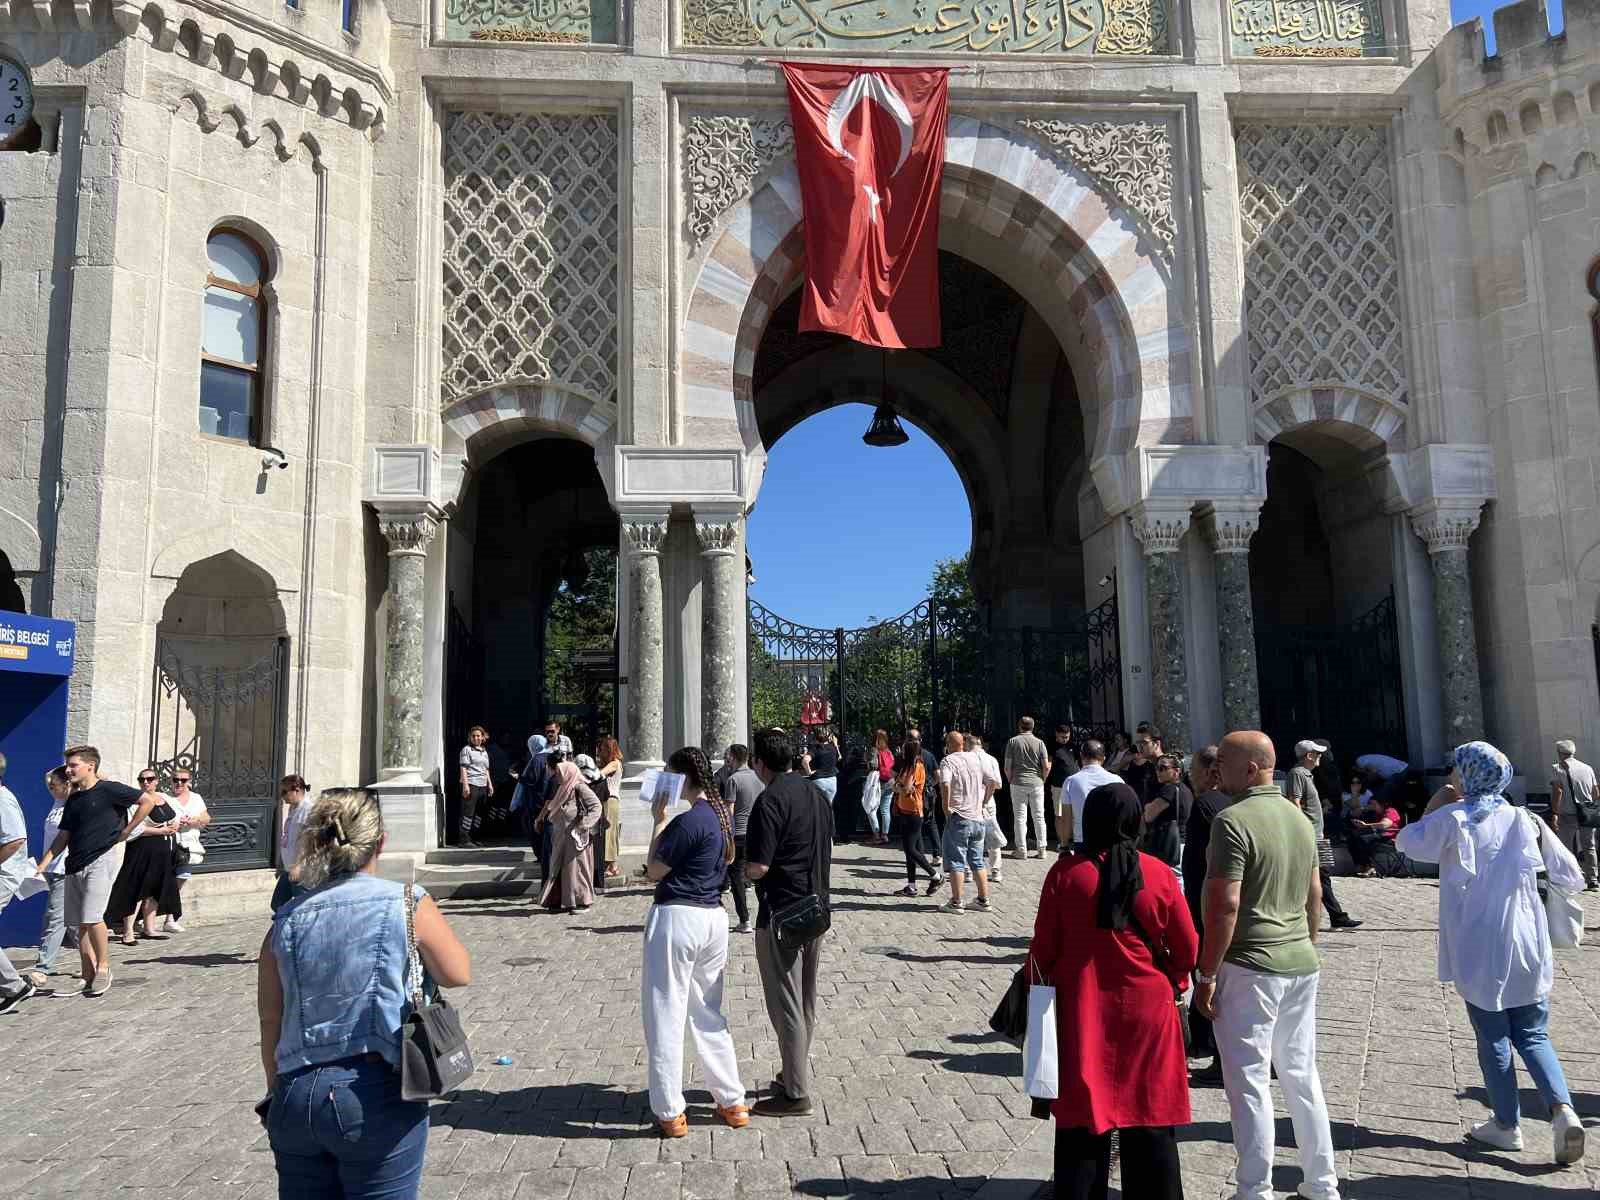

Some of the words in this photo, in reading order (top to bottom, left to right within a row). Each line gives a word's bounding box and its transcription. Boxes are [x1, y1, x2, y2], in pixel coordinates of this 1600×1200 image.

[8, 78, 18, 91] 2
[13, 96, 24, 109] 3
[4, 113, 17, 126] 4
[17, 630, 50, 646] BELGESİ
